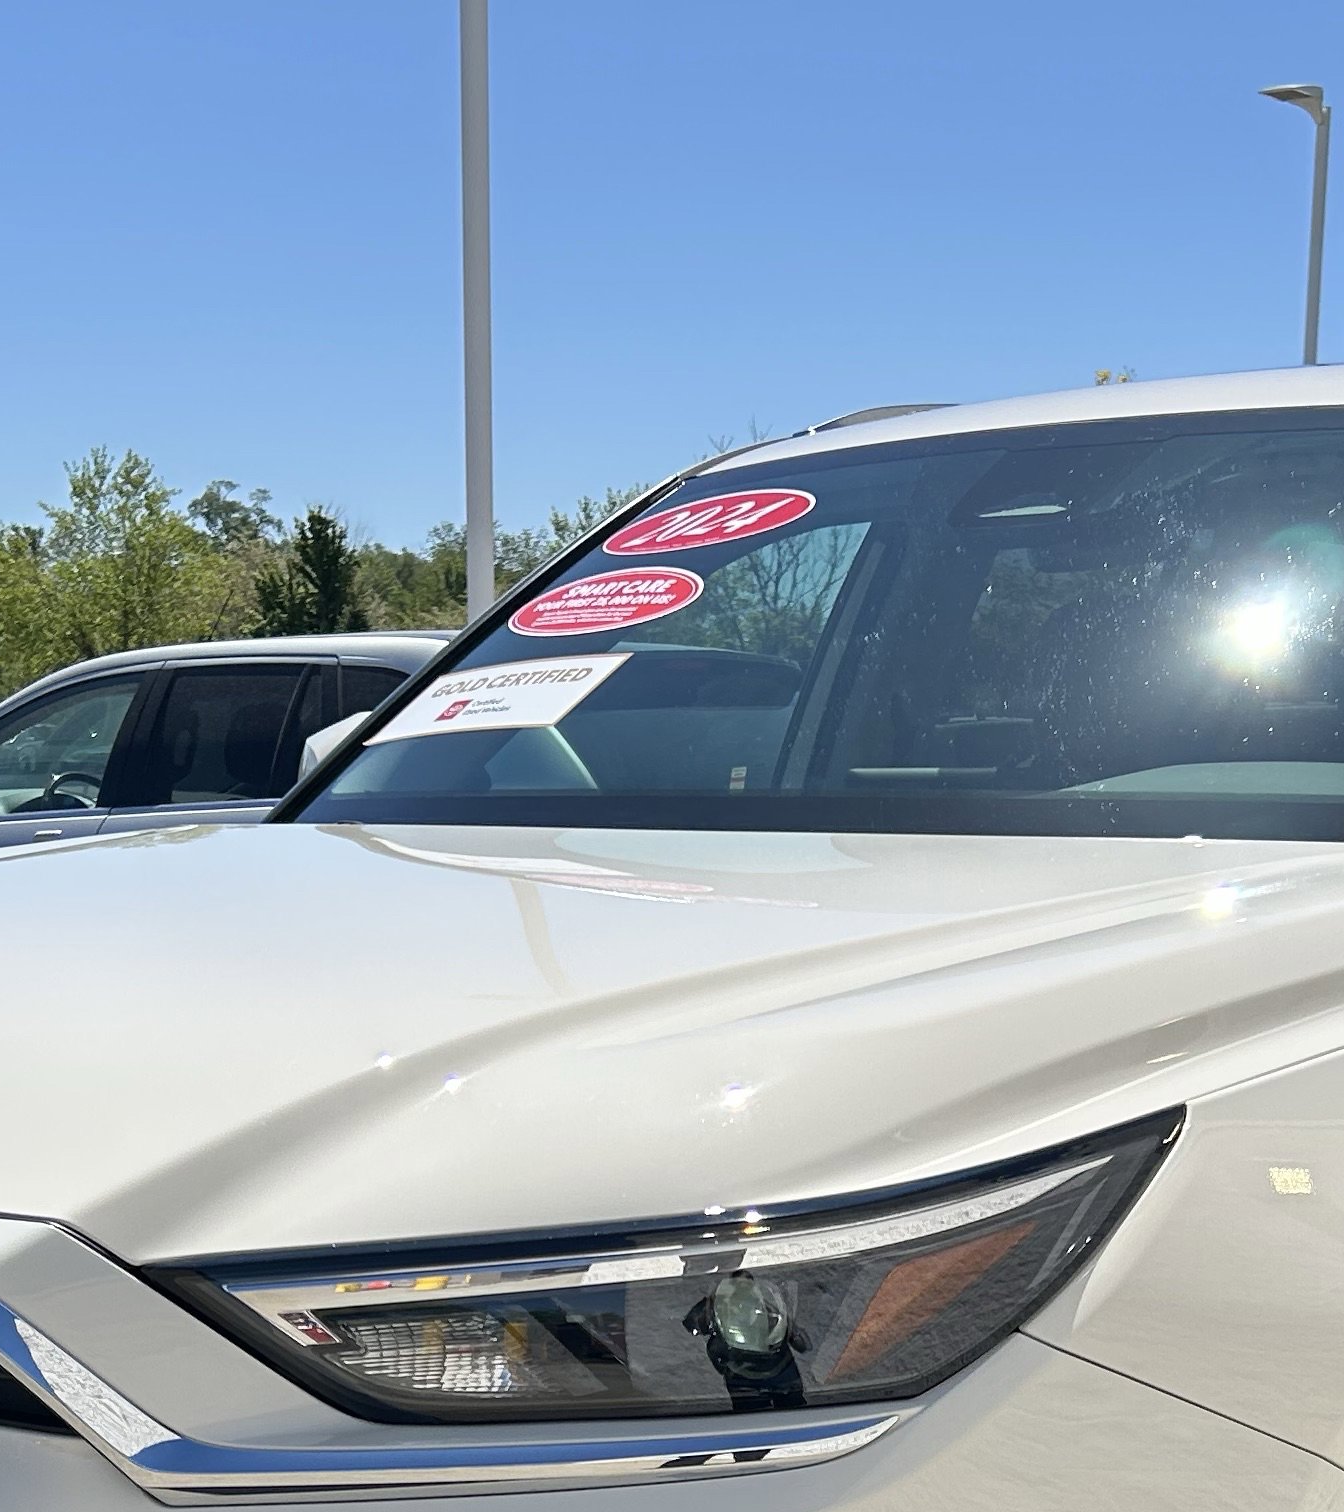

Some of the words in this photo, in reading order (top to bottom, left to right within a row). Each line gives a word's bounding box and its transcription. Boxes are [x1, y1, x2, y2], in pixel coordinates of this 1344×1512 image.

[620, 497, 796, 548] 2024
[562, 580, 627, 599] SMART
[622, 579, 678, 595] CARE
[432, 677, 488, 698] GOLD
[486, 667, 593, 689] CERTIFIED
